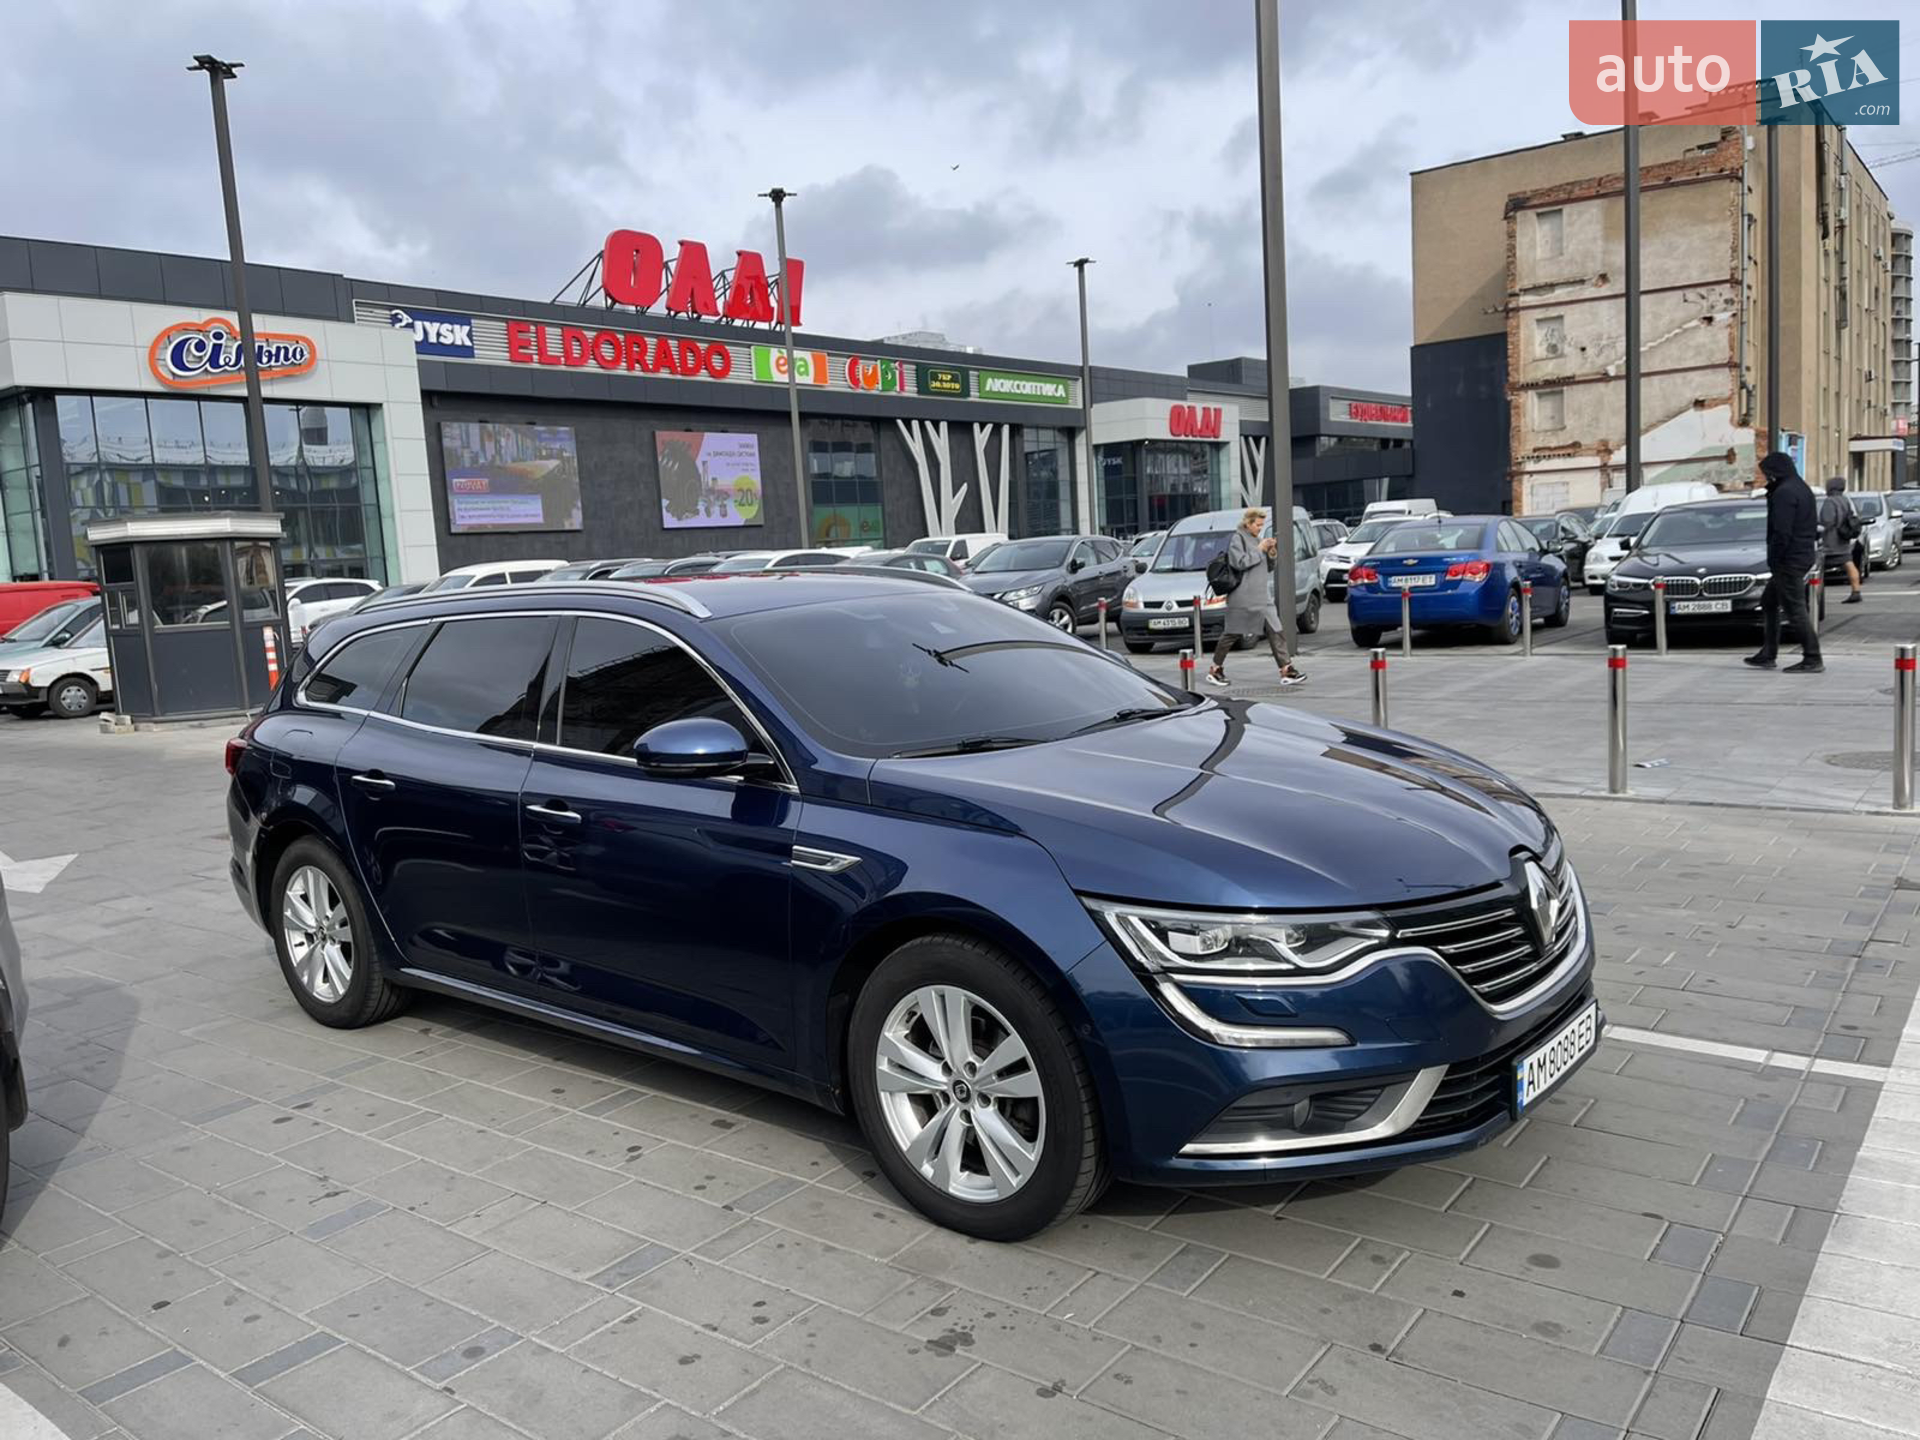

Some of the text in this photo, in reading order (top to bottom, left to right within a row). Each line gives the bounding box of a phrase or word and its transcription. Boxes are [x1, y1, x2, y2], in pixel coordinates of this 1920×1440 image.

[413, 320, 473, 346] JYSK
[507, 320, 732, 379] ELDORADO
[985, 377, 1066, 398] ЛЮКСОПТИКА
